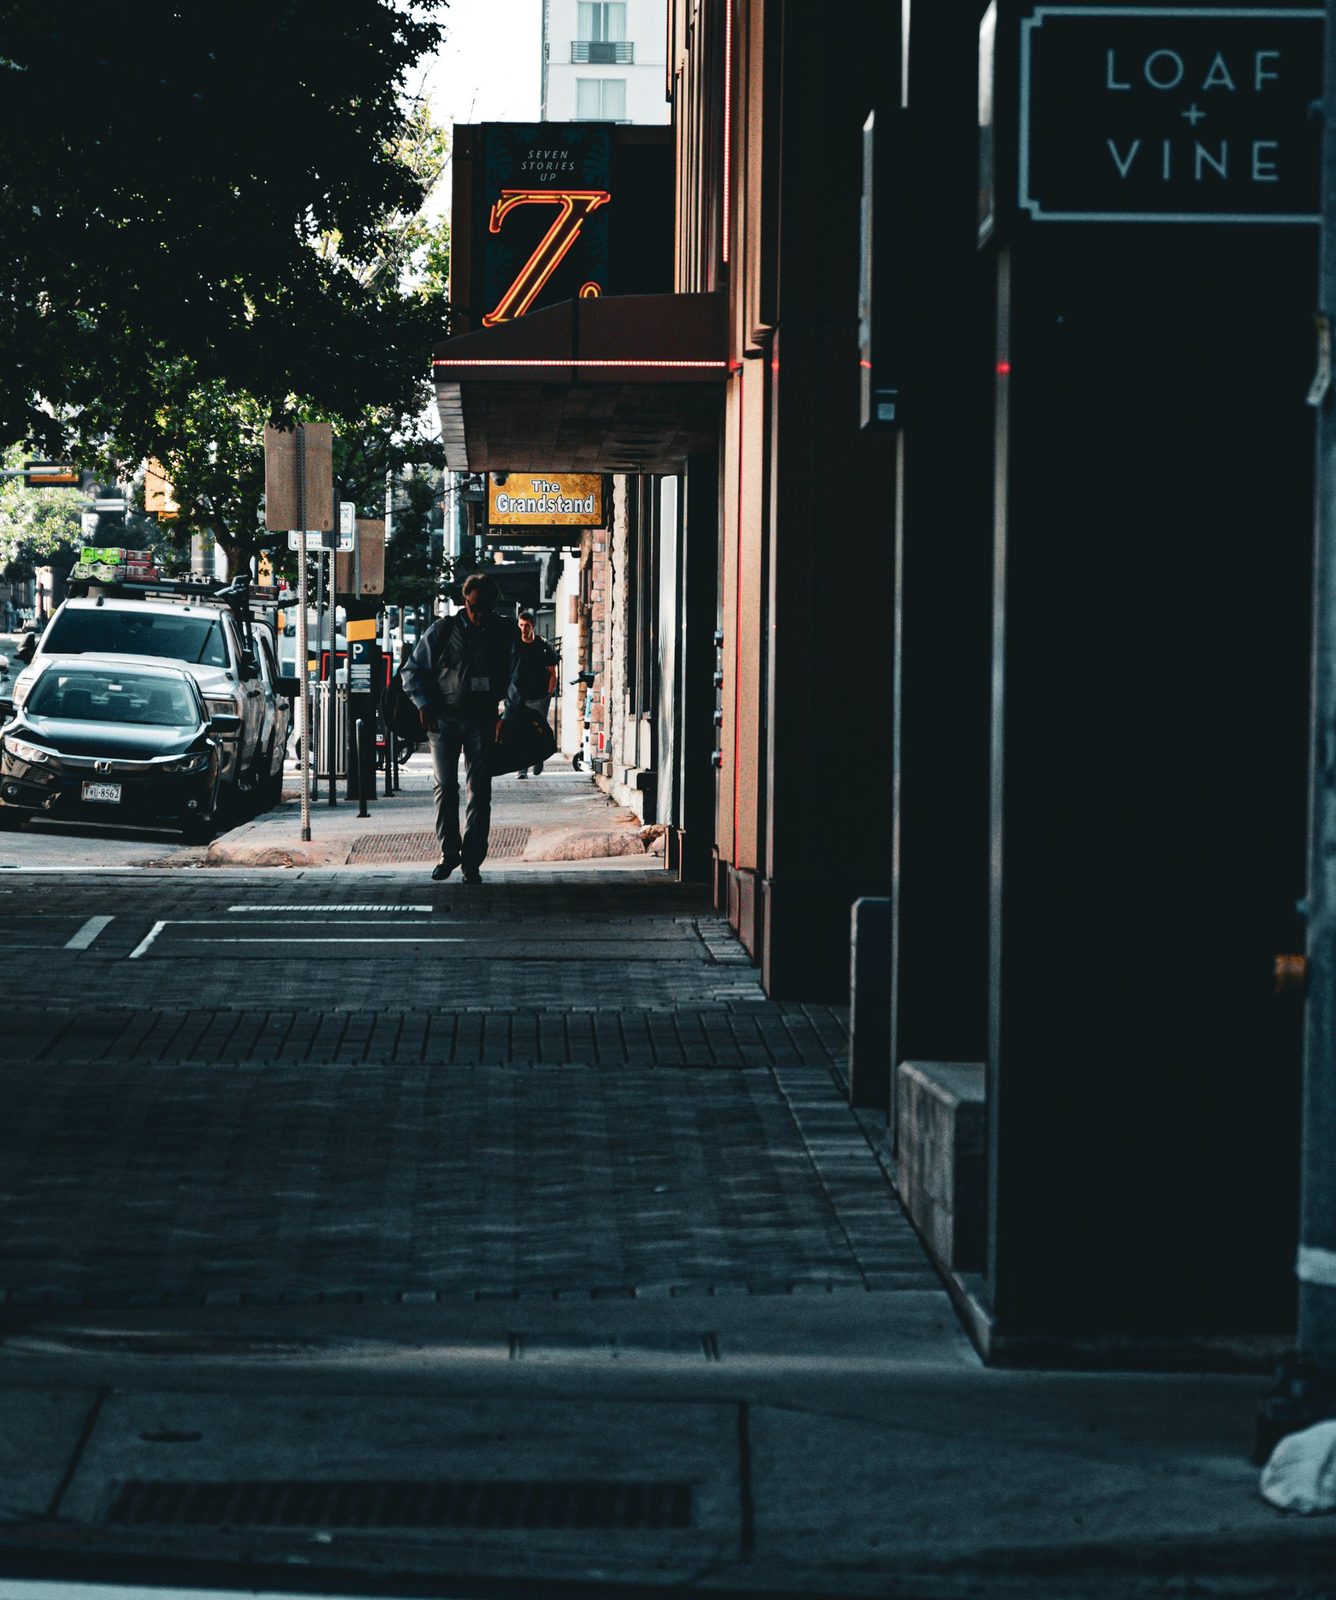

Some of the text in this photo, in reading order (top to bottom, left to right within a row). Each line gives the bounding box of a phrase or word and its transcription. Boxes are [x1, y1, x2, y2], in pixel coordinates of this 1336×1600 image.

[1106, 48, 1280, 91] LOAF
[1181, 102, 1206, 126] +
[527, 149, 569, 159] SEVEN
[1107, 138, 1278, 180] VINE
[521, 161, 576, 171] STORIES
[540, 172, 557, 181] UP
[531, 480, 560, 493] The
[496, 494, 594, 514] Grandstand
[353, 643, 363, 660] P
